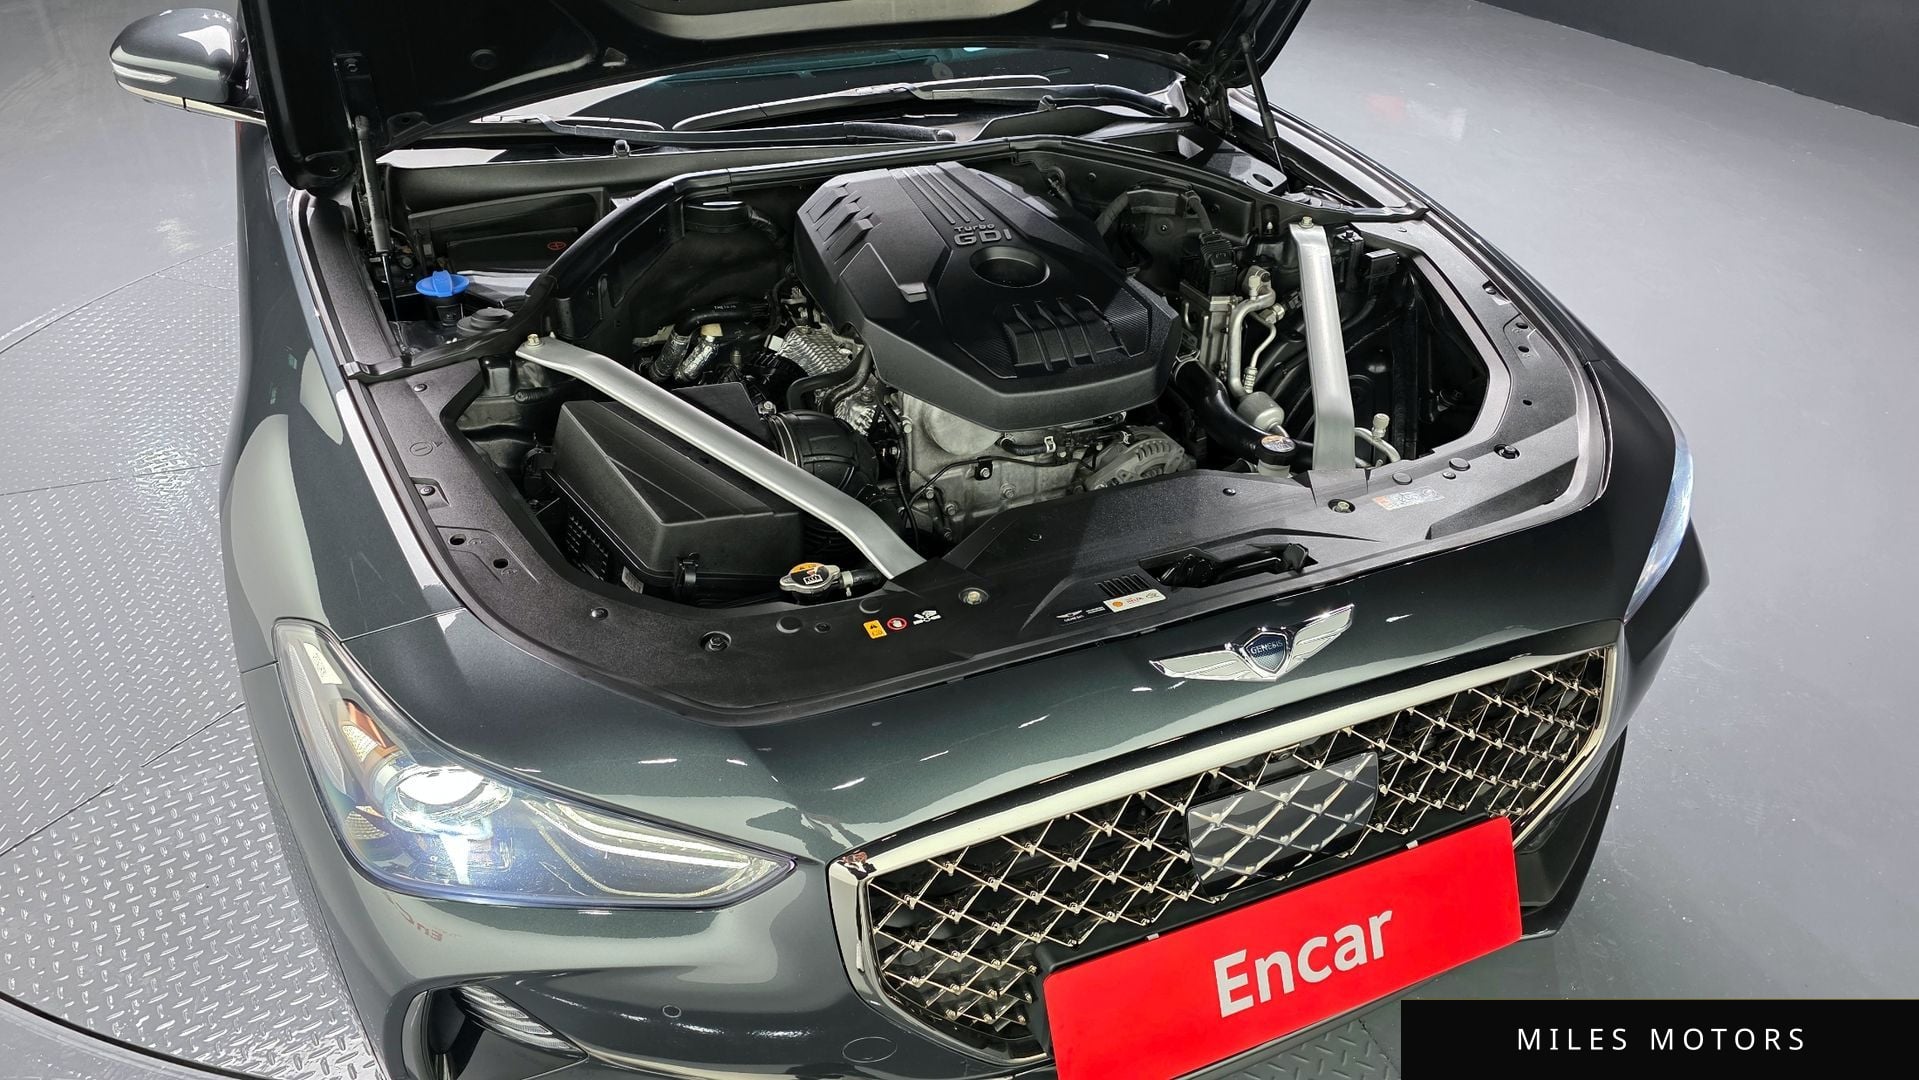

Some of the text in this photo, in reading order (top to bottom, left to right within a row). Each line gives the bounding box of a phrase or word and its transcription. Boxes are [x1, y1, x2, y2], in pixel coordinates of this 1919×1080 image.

[954, 223, 995, 232] Turbo
[954, 228, 1012, 246] GDI
[1250, 640, 1283, 654] GENESIS
[1214, 910, 1393, 1018] Encar
